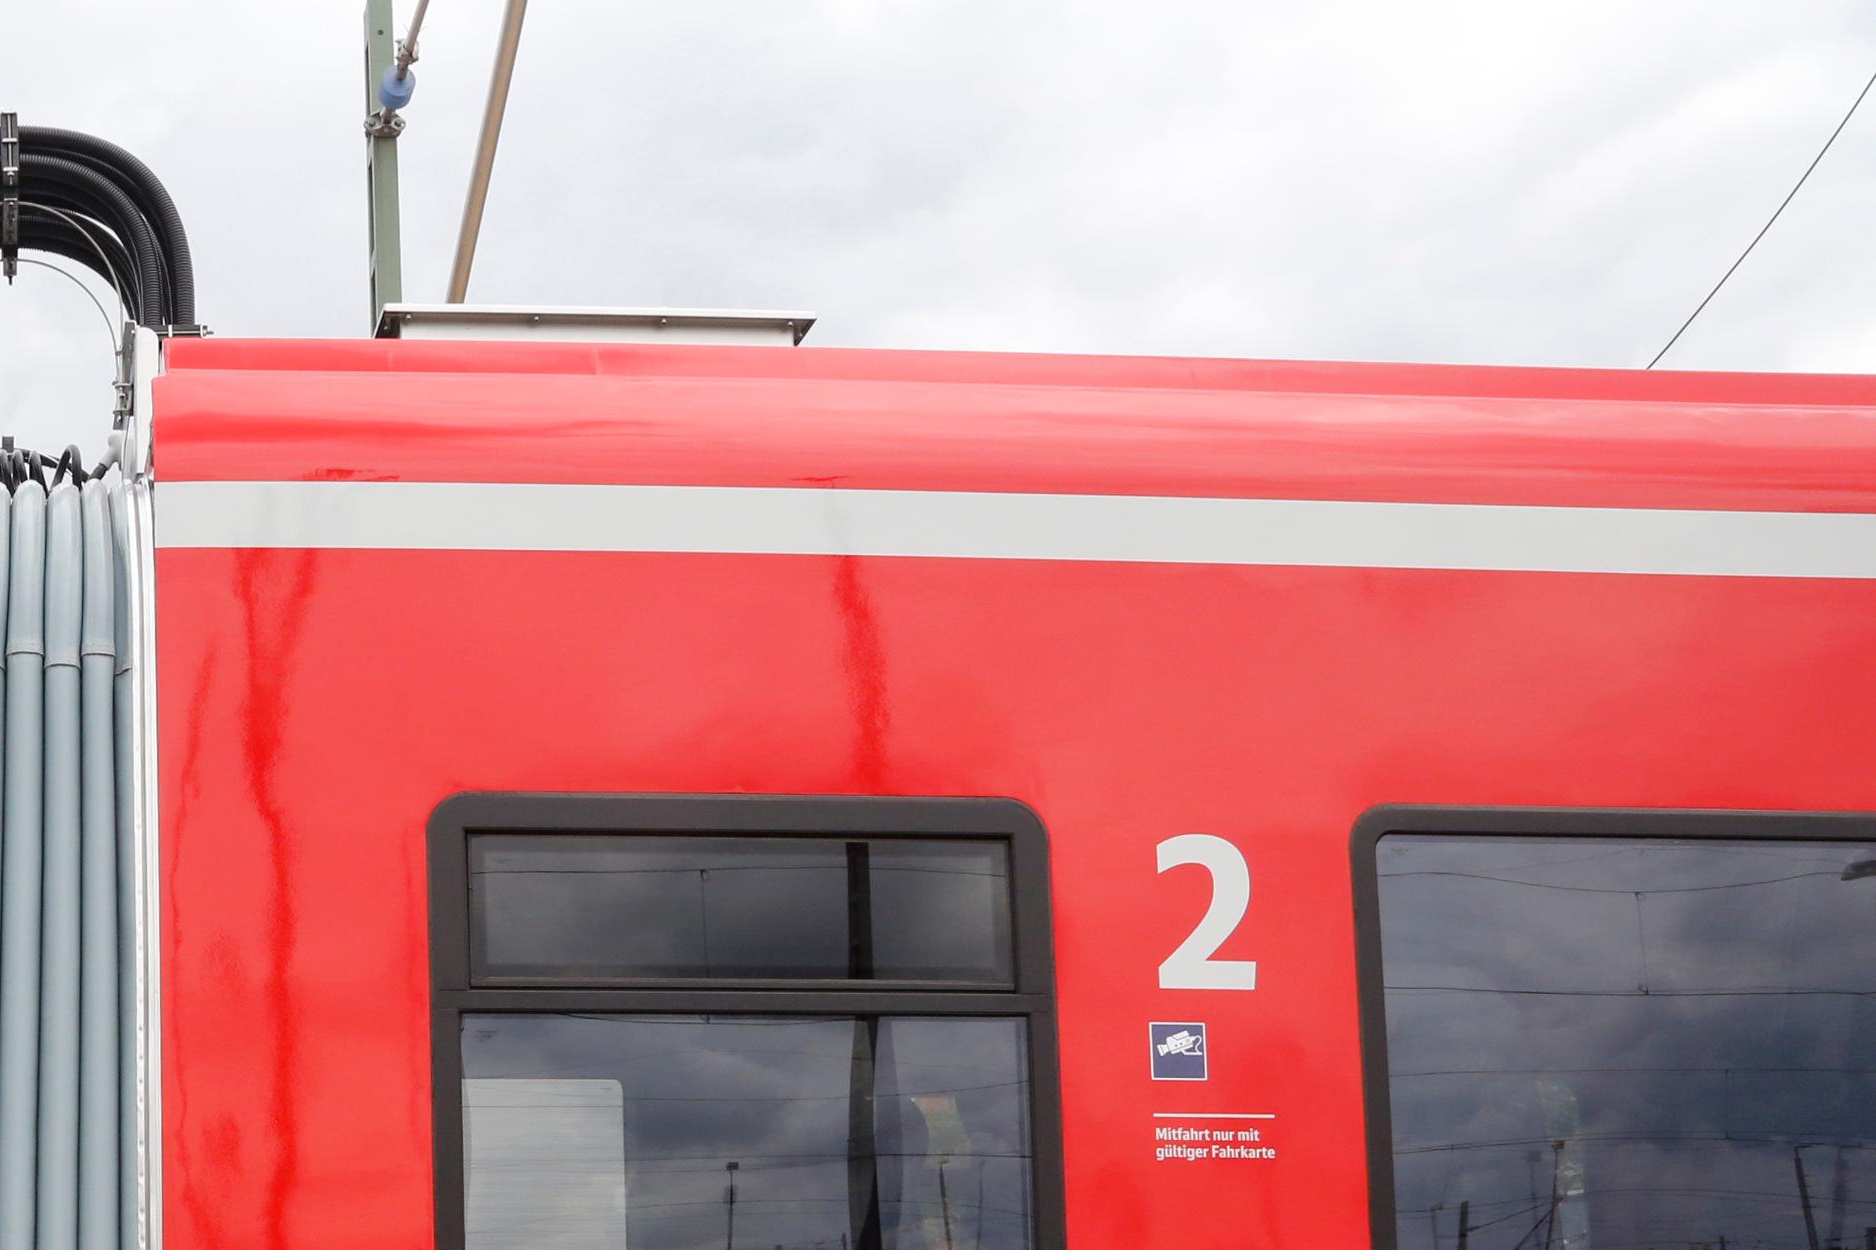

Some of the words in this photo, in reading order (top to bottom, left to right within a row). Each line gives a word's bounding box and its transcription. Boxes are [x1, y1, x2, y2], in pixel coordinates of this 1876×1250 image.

[1156, 833, 1257, 990] 2
[1155, 1127, 1210, 1141] Mitfahrt
[1212, 1130, 1235, 1141] nur
[1237, 1127, 1260, 1141] mit
[1156, 1144, 1209, 1161] gültiger
[1211, 1145, 1276, 1159] Fahrkarte
